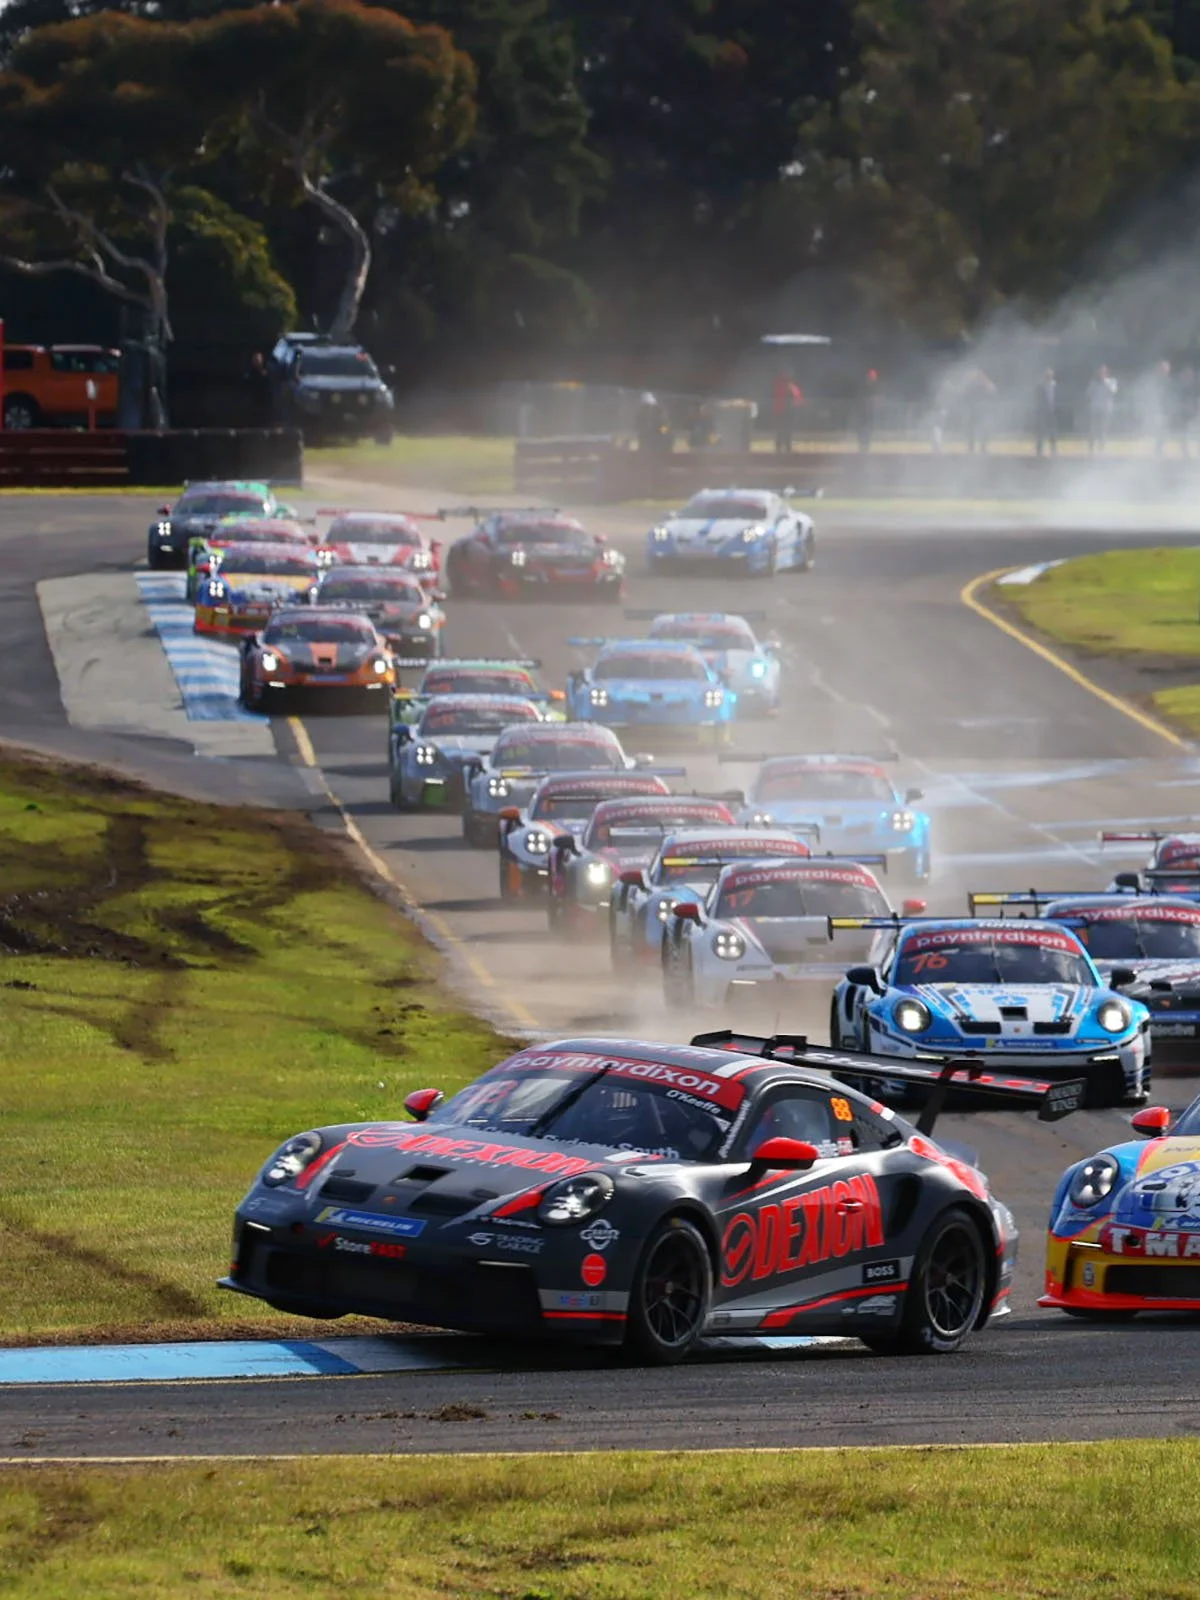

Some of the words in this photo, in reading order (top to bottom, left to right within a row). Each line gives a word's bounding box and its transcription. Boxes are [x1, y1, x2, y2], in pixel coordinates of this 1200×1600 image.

[734, 870, 867, 886] paynterdixon
[916, 930, 1068, 949] paynterdixon
[908, 952, 949, 974] 76
[505, 1054, 722, 1096] paynterdixon
[666, 1089, 721, 1115] O'Keeffe
[829, 1096, 854, 1122] 88
[395, 1133, 602, 1175] DEXION
[345, 1215, 414, 1231] MICHELIN
[750, 1171, 886, 1281] DEXION
[866, 1264, 895, 1278] BOSS
